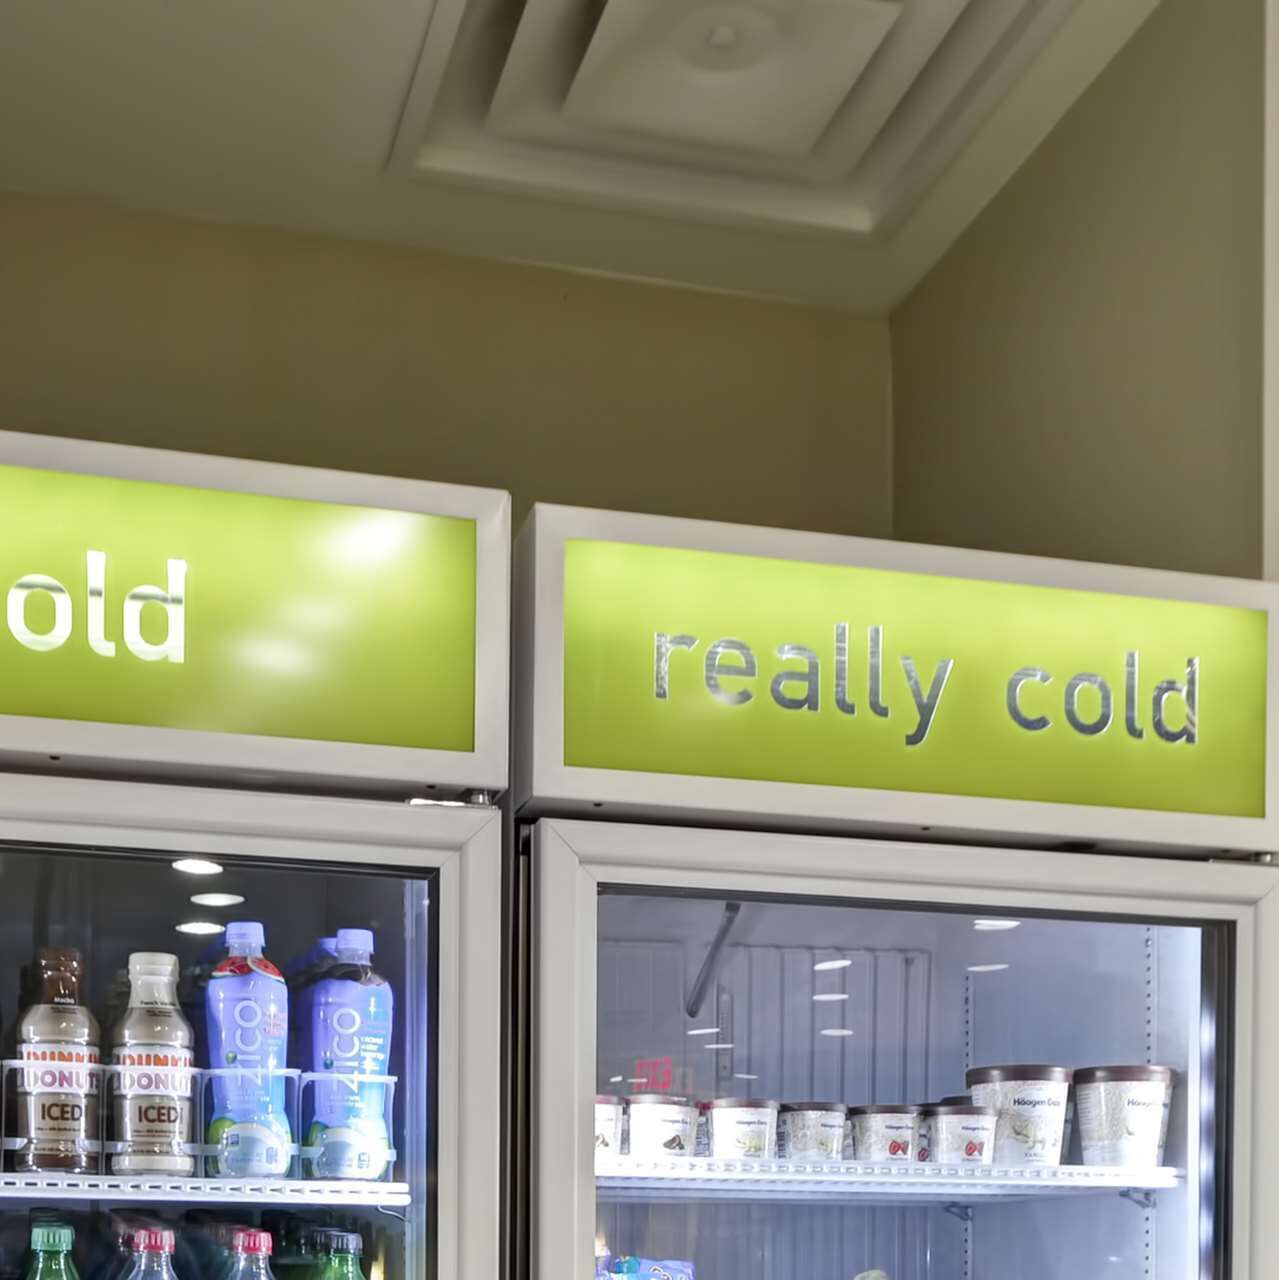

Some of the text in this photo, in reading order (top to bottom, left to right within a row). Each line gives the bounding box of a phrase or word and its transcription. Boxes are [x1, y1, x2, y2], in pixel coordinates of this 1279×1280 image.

[655, 623, 1200, 746] really cold
[41, 1103, 83, 1121] ICED
[138, 1105, 179, 1124] ICED
